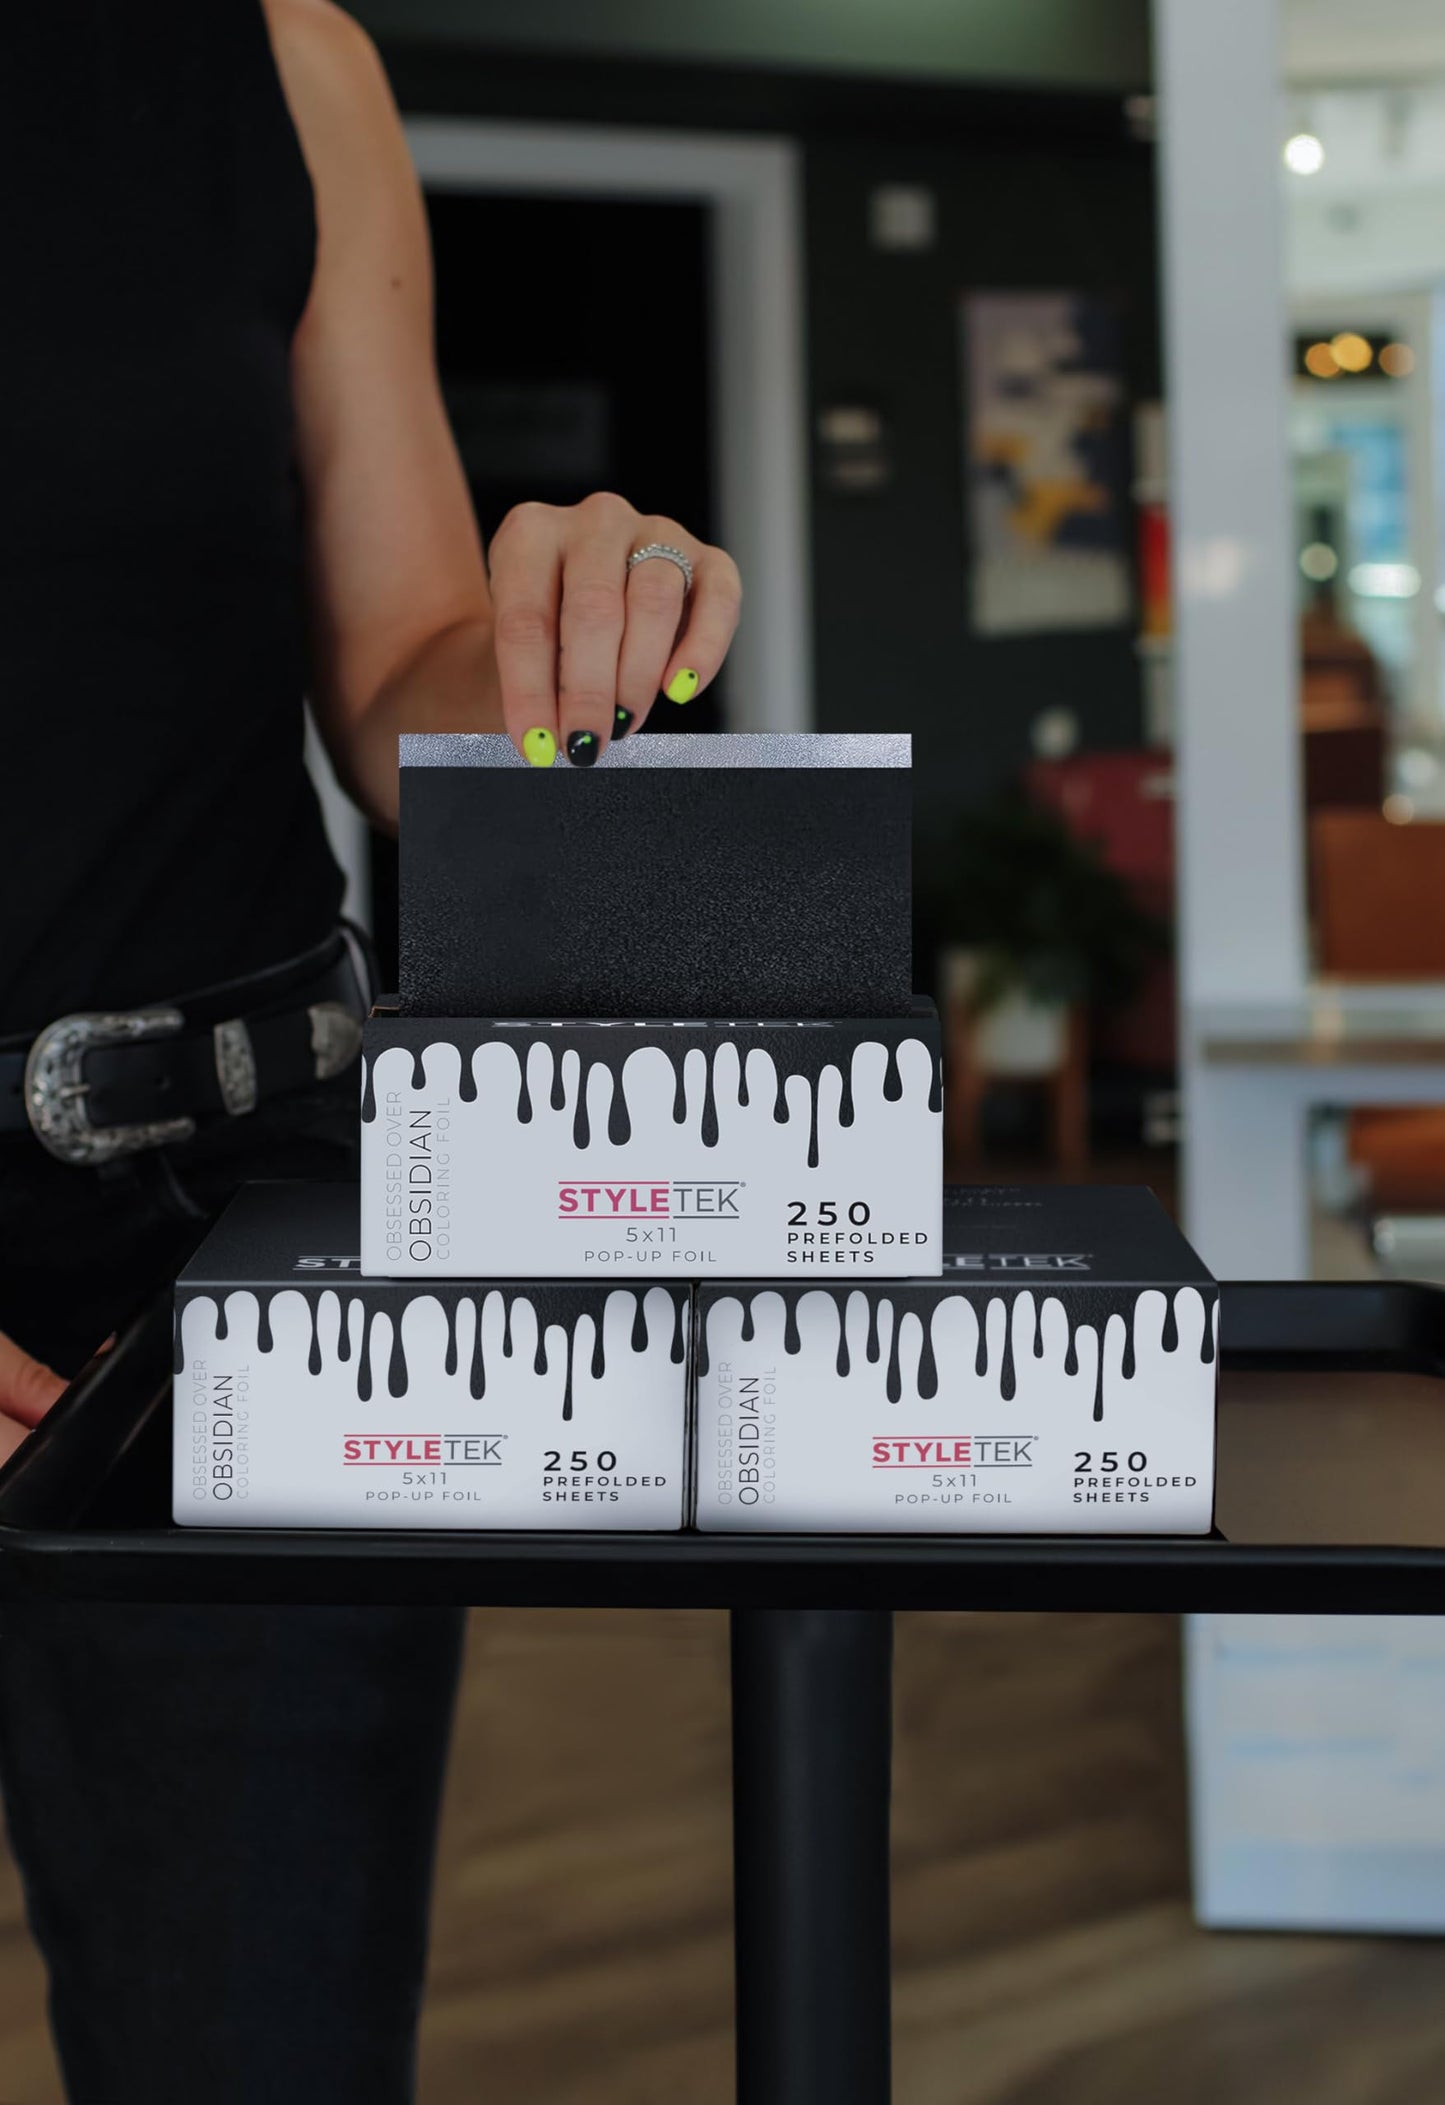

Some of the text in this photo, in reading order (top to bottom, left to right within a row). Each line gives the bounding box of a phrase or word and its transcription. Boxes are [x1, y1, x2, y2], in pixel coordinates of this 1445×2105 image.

[386, 1091, 402, 1261] OBSESSED OVER
[437, 1097, 450, 1260] COLORING FOIL
[409, 1111, 431, 1261] OBSIDIAN
[788, 1202, 870, 1226] 250
[626, 1227, 675, 1242] 5x11
[788, 1233, 927, 1244] PREFOLDED
[585, 1251, 716, 1262] POP-UP FOIL
[787, 1251, 873, 1262] SHEETS
[193, 1360, 207, 1500] OBSESSED OVER
[213, 1376, 233, 1500] OBSIDIAN
[237, 1365, 249, 1499] COLORING FOIL
[718, 1361, 732, 1505] OBSESSED OVER
[763, 1366, 776, 1504] COLORING FOIL
[739, 1378, 759, 1505] OBSIDIAN
[544, 1451, 616, 1471] 250
[1075, 1452, 1147, 1472] 250
[403, 1472, 446, 1484] 5x11
[544, 1477, 666, 1486] PREFOLDED
[932, 1474, 976, 1487] 5x11
[1074, 1477, 1196, 1487] PREFOLDED
[366, 1491, 480, 1501] POP-UP FOIL
[543, 1492, 618, 1501] SHEETS
[895, 1494, 1011, 1504] POP-UP FOIL
[1074, 1492, 1149, 1503] SHEETS
